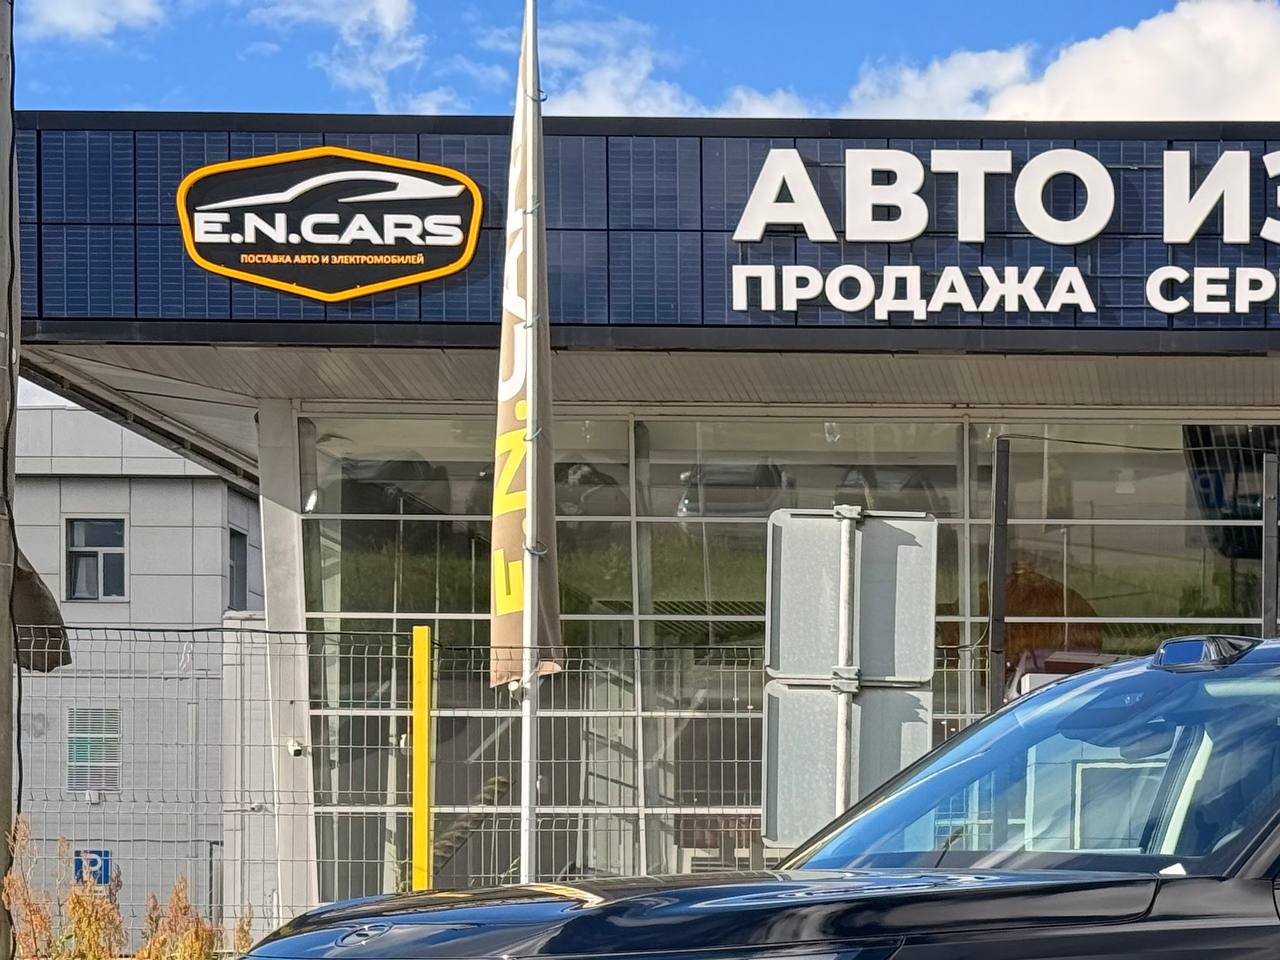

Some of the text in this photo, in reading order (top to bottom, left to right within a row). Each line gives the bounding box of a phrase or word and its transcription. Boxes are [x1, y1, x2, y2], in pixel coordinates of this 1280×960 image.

[731, 147, 1115, 246] АВТО
[193, 212, 464, 247] E.N.CARS
[240, 252, 424, 265] ПОСТАВКА АВТО И ЭЛЕКТРОМОБИЛЕЙ
[731, 264, 1097, 321] ПРОДАЖА
